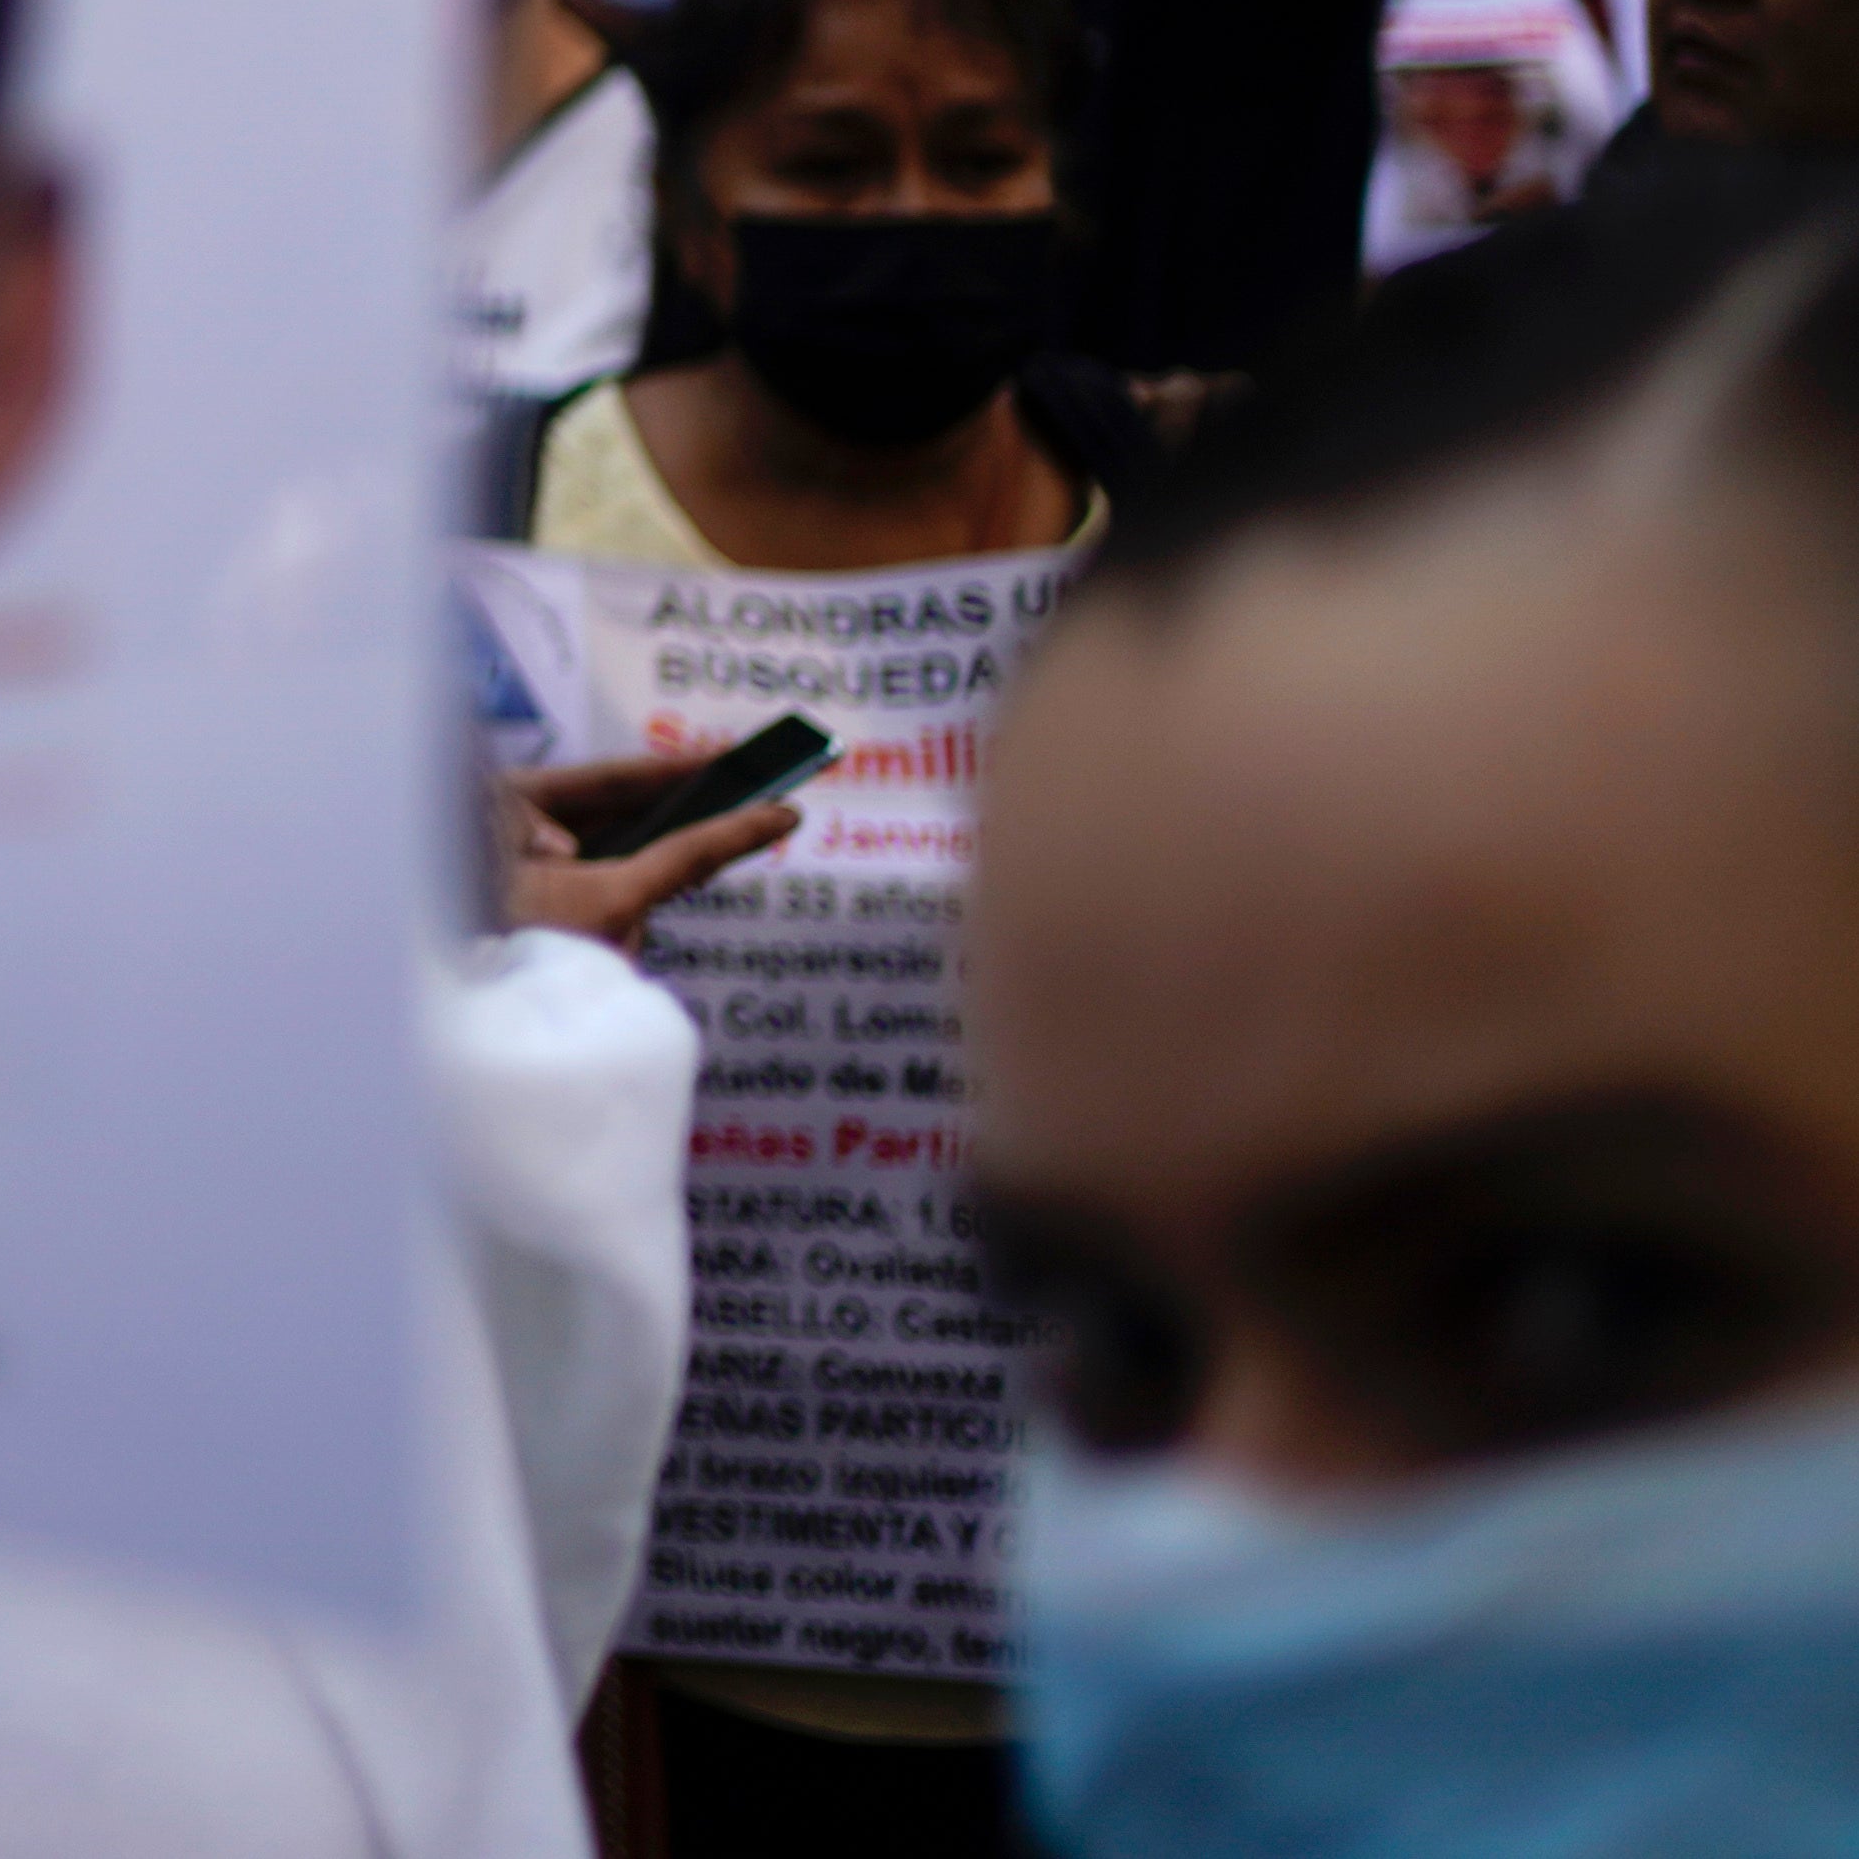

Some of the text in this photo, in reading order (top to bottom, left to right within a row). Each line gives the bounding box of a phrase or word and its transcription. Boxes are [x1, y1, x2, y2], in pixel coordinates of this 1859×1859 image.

[649, 580, 992, 642] ALONDRAS
[689, 1114, 818, 1167] eñas
[686, 1184, 901, 1234] STATURA:
[690, 1289, 887, 1338] ABELLO:
[679, 1393, 1026, 1454] EÑAS PARTICU
